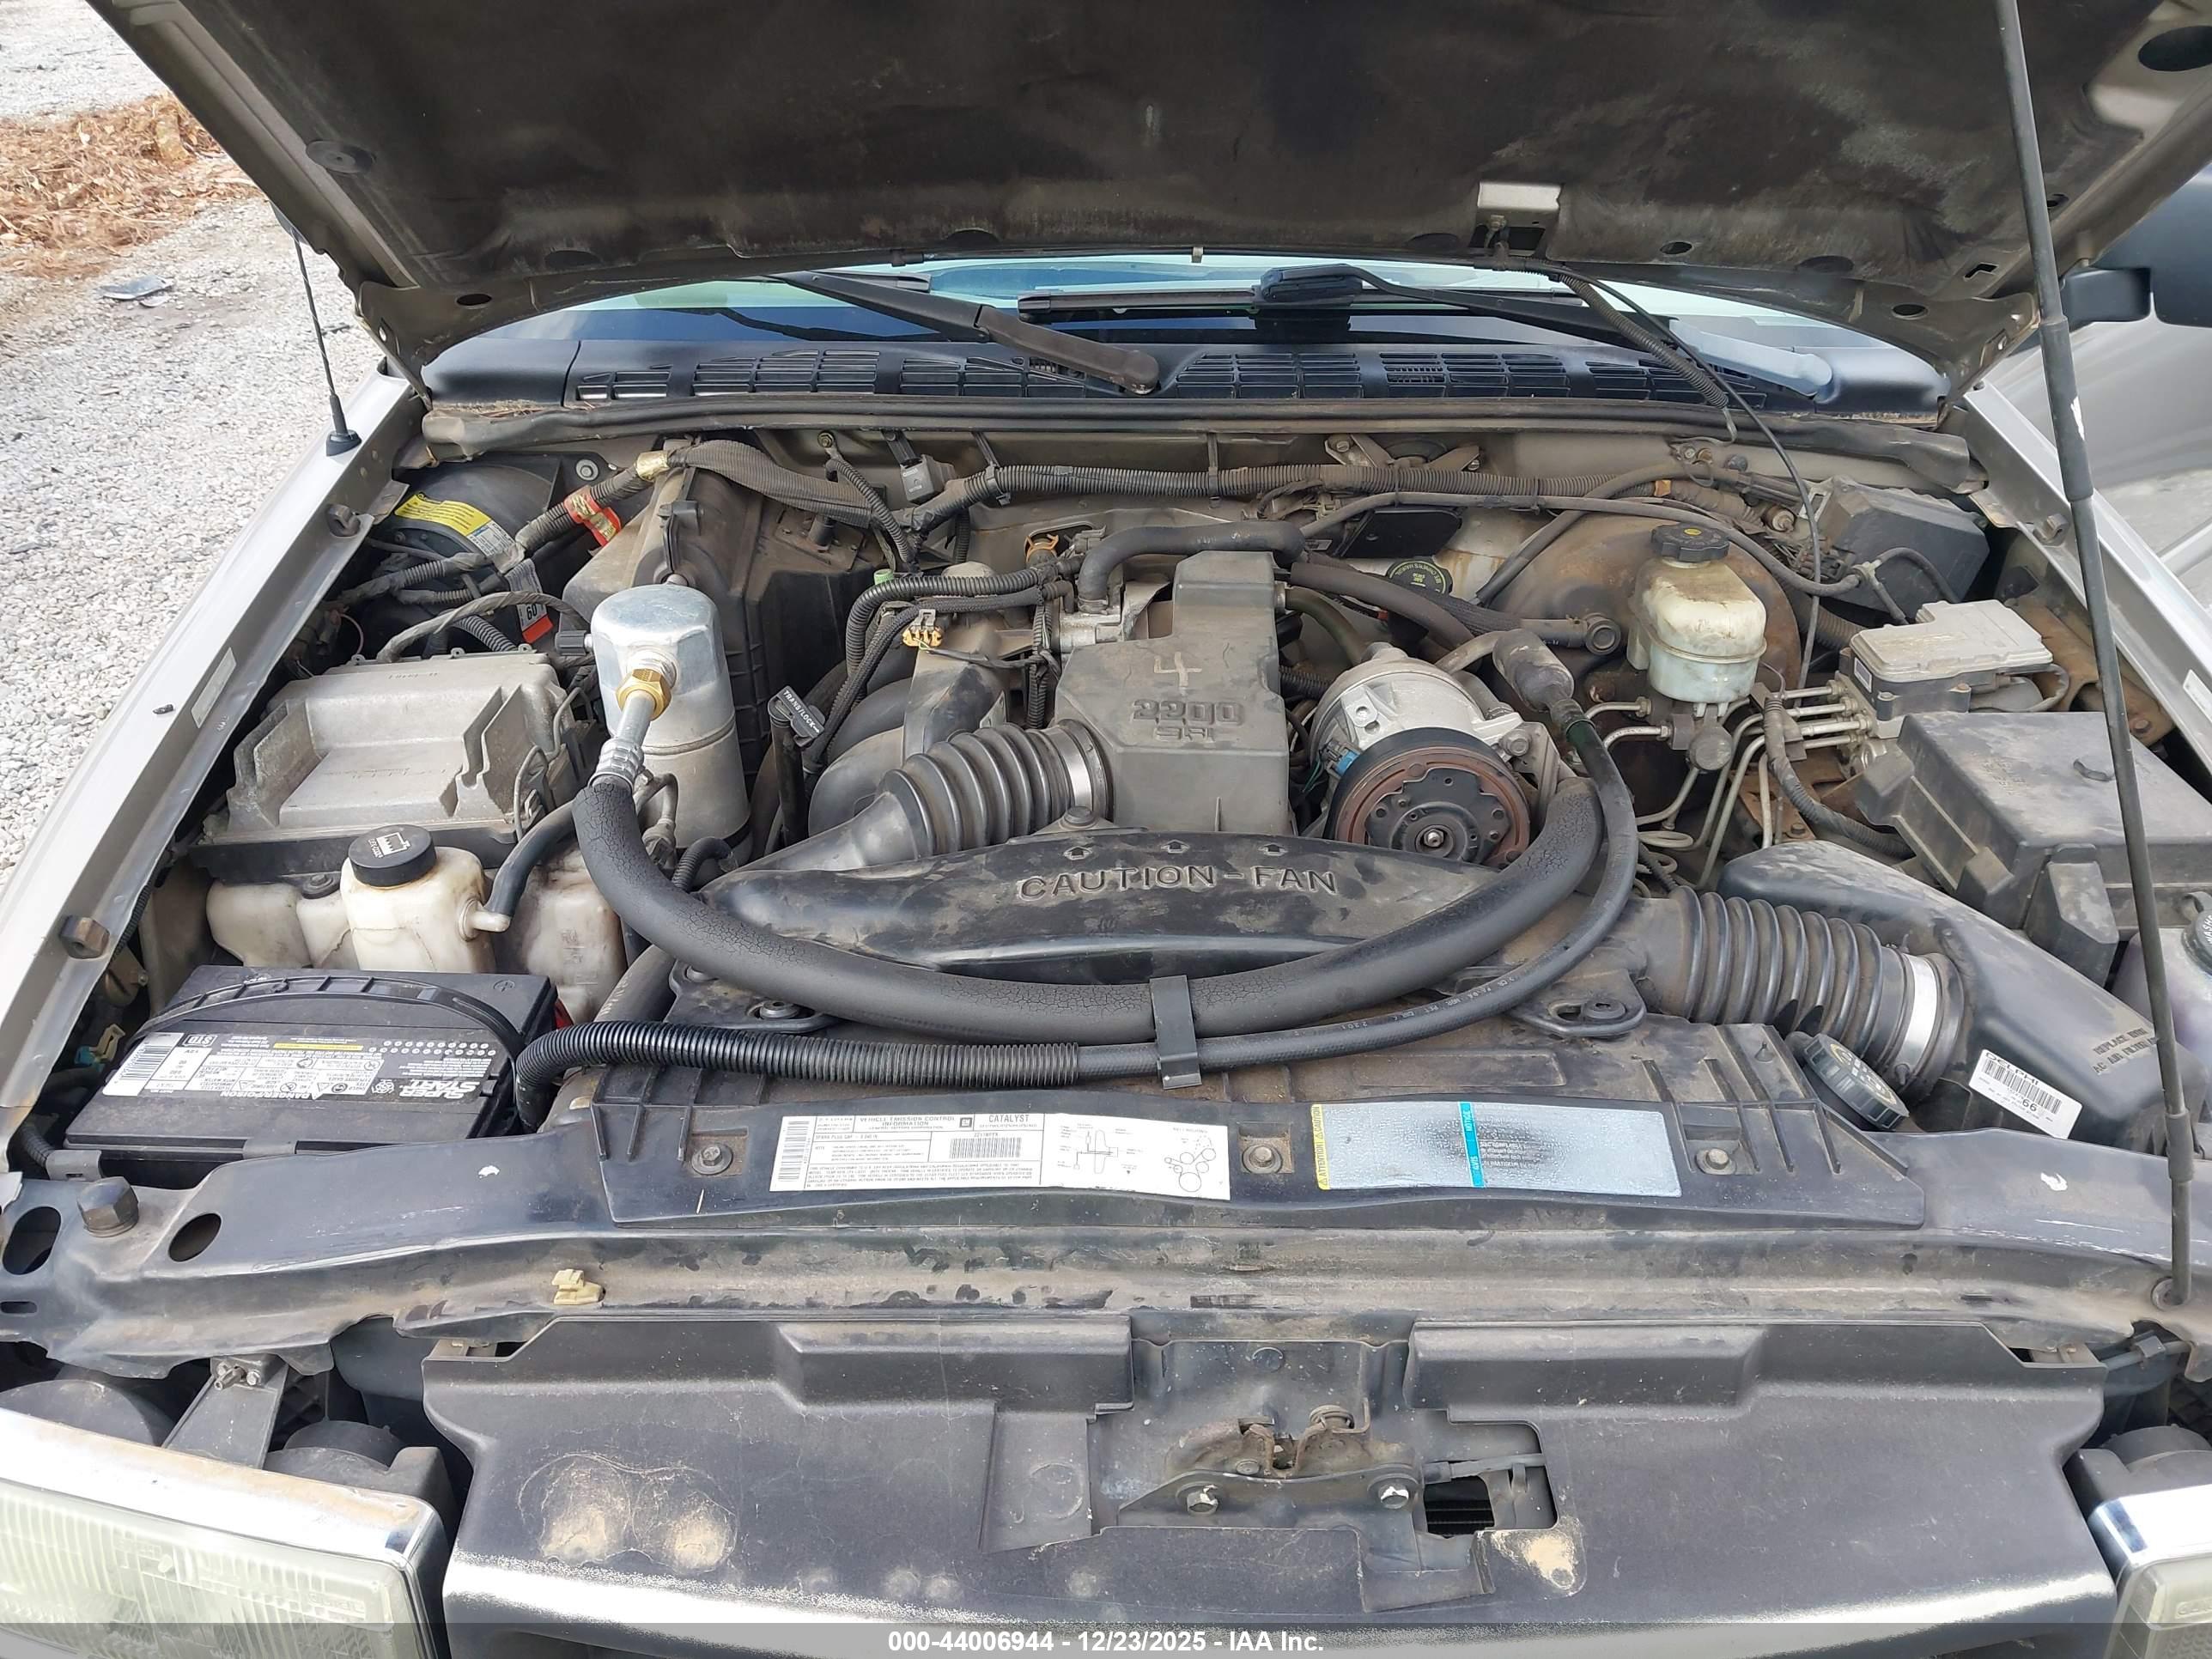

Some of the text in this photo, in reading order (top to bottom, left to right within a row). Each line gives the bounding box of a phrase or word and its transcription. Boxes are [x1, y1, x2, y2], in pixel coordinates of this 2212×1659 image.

[783, 690, 815, 727] TRANS/LOCK
[1132, 699, 1244, 726] 2200
[1985, 1052, 2039, 1085] DELPHI
[2093, 1062, 2107, 1073] AC
[398, 1087, 465, 1099] SUPER
[409, 1079, 481, 1093] START
[2022, 1098, 2038, 1112] 66
[1311, 1106, 1322, 1132] CAUTION
[1462, 1110, 1473, 1132] NOTICE
[1315, 1145, 1327, 1176] ATTENTION
[1470, 1156, 1480, 1170] AVIS
